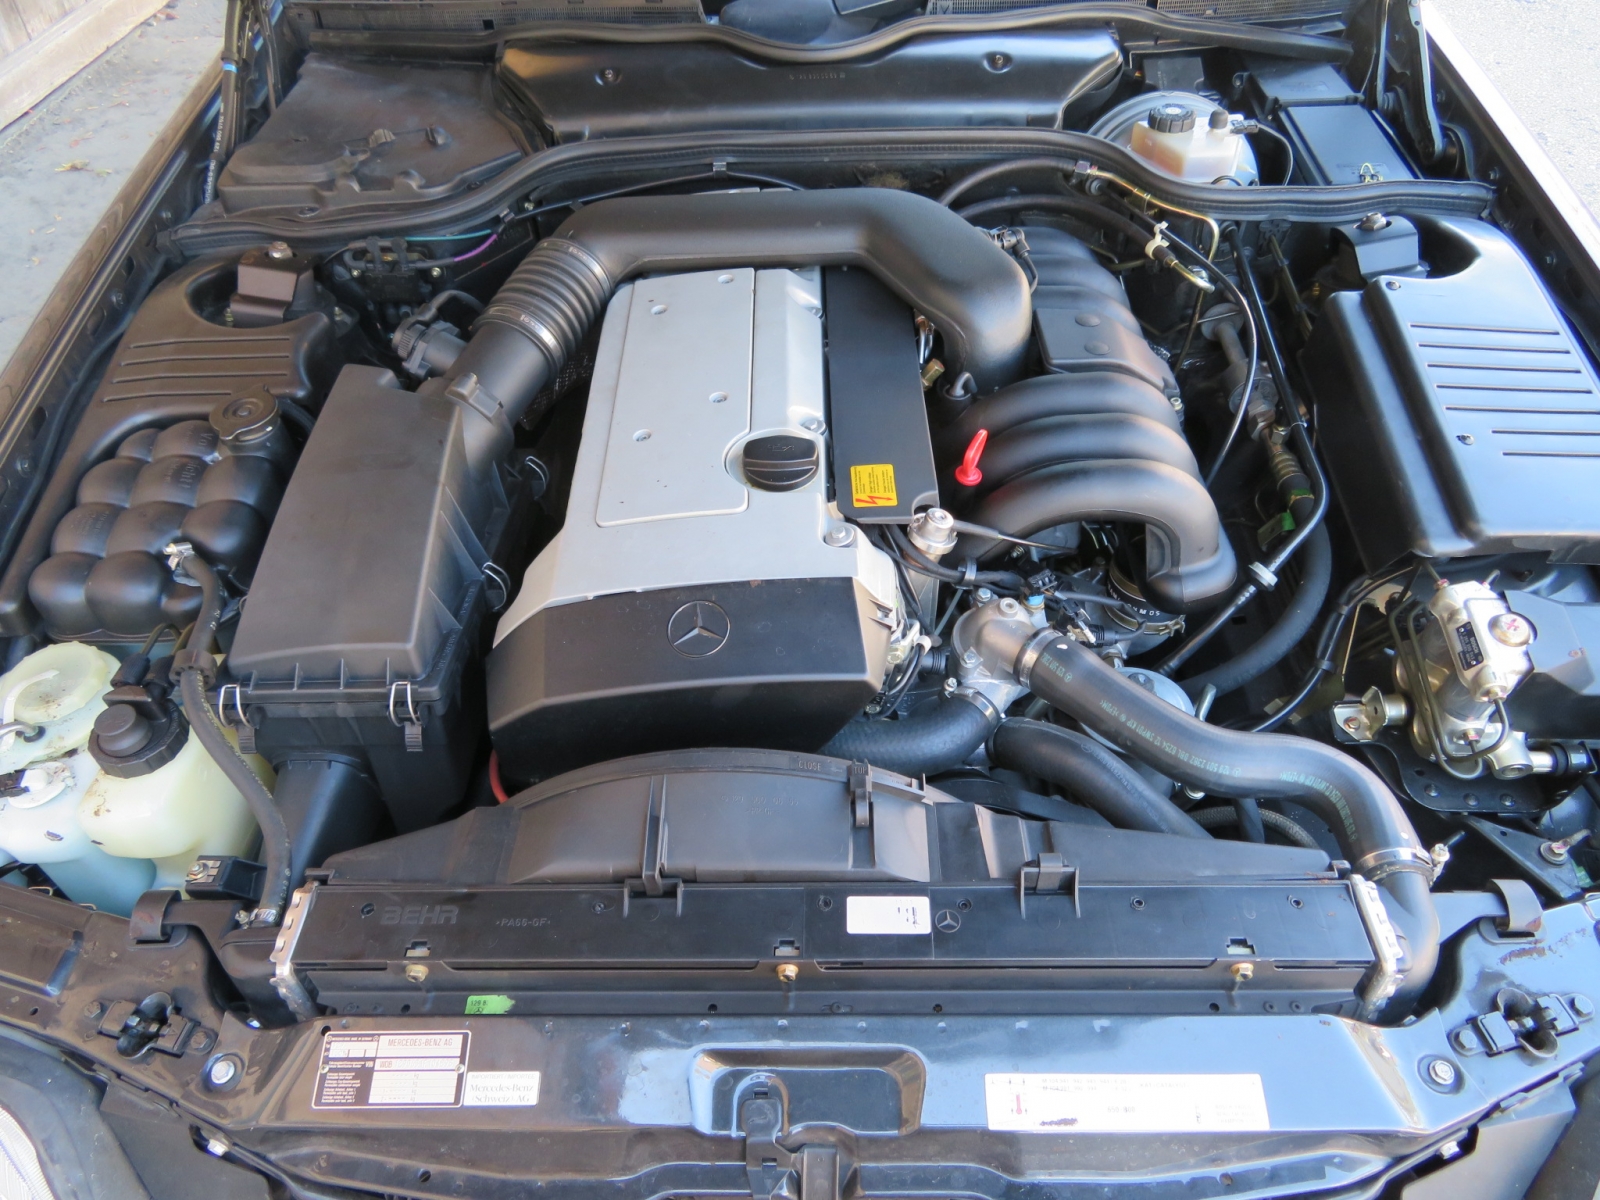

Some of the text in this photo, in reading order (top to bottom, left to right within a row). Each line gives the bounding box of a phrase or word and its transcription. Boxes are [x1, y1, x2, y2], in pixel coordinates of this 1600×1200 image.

[798, 760, 821, 771] CLOSE
[854, 765, 867, 774] TOP
[380, 905, 459, 925] BEHR
[387, 1038, 453, 1047] MERCEDES-BENZ AG
[379, 1060, 393, 1069] WDB
[470, 1083, 534, 1093] Mercedes-Benz
[517, 1094, 530, 1103] AG
